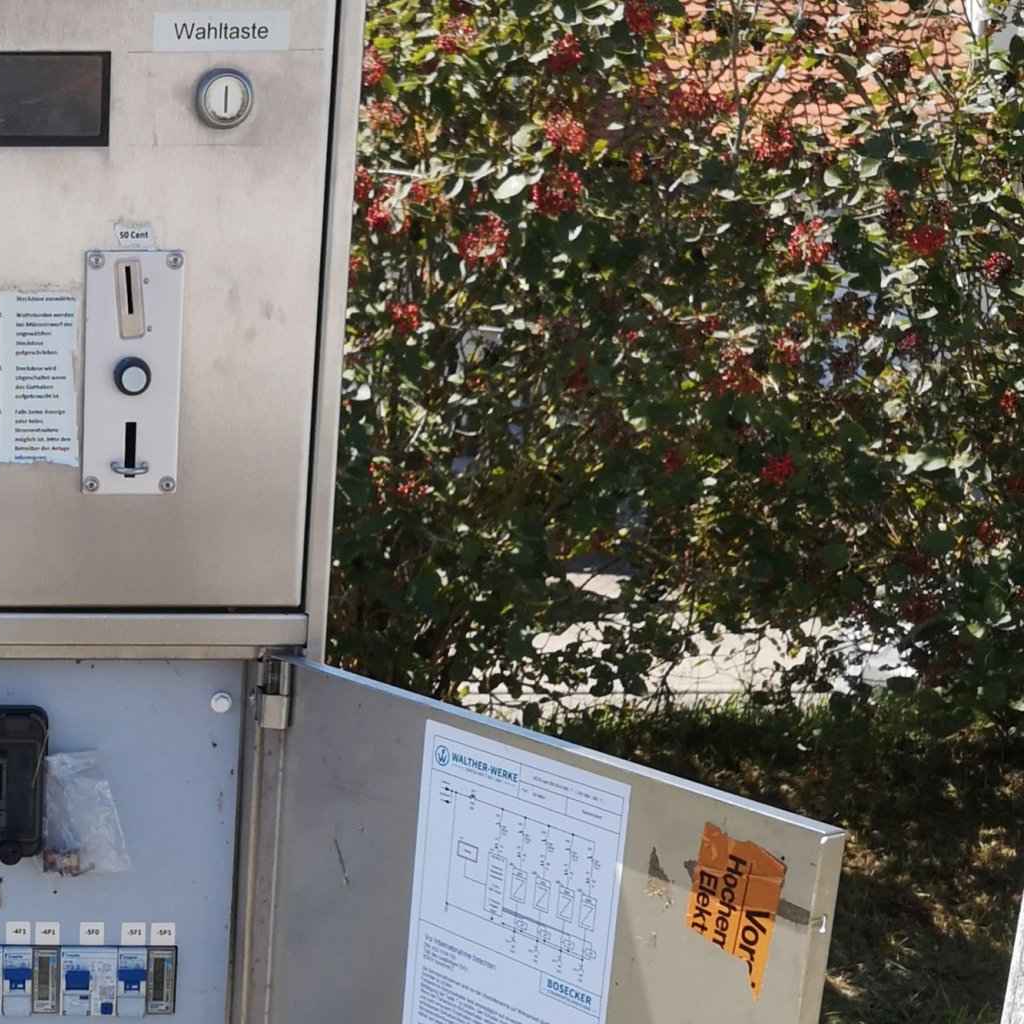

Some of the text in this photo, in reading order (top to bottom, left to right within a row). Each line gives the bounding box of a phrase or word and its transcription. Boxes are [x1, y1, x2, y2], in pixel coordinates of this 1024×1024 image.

[174, 22, 269, 40] Wahltaste
[119, 231, 149, 239] 50 Cent
[452, 752, 518, 784] WALTHER-WERKE
[547, 978, 592, 1006] BOSECKER
